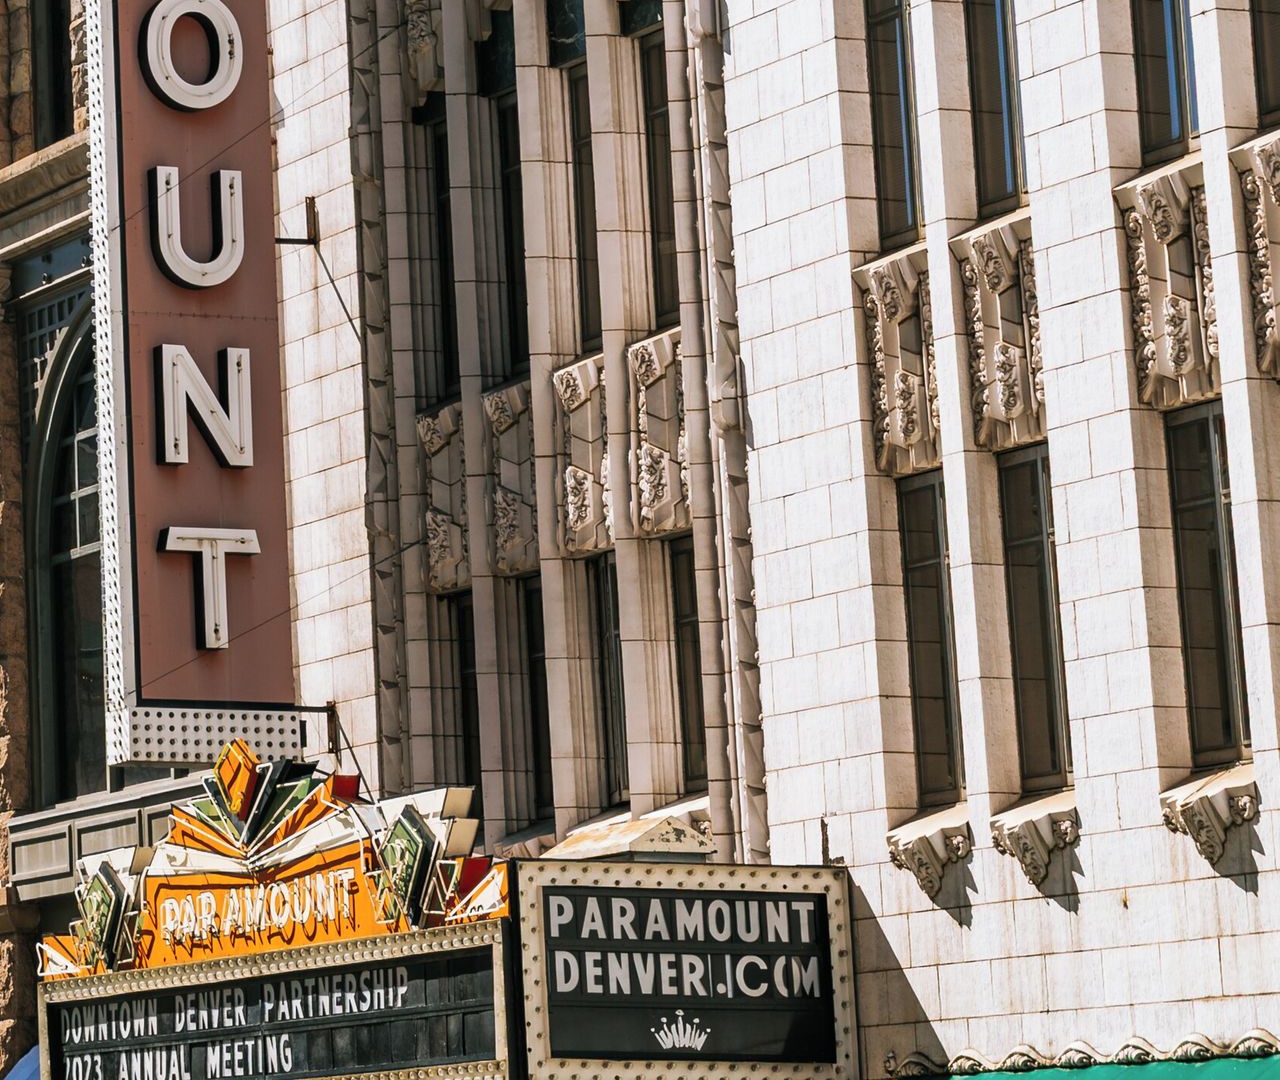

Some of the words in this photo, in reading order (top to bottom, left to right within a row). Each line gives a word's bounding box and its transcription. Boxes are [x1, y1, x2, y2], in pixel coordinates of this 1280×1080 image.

[160, 868, 355, 946] PARAMOUNT
[548, 895, 815, 943] PARAMOUNT
[554, 950, 821, 998] DENVER.COM
[61, 998, 158, 1044] DOWNTOWN
[175, 987, 246, 1033] DENVER
[264, 967, 409, 1024] PARTNERSHIP
[119, 1043, 191, 1080] ANNUAL
[207, 1033, 293, 1079] MEETING
